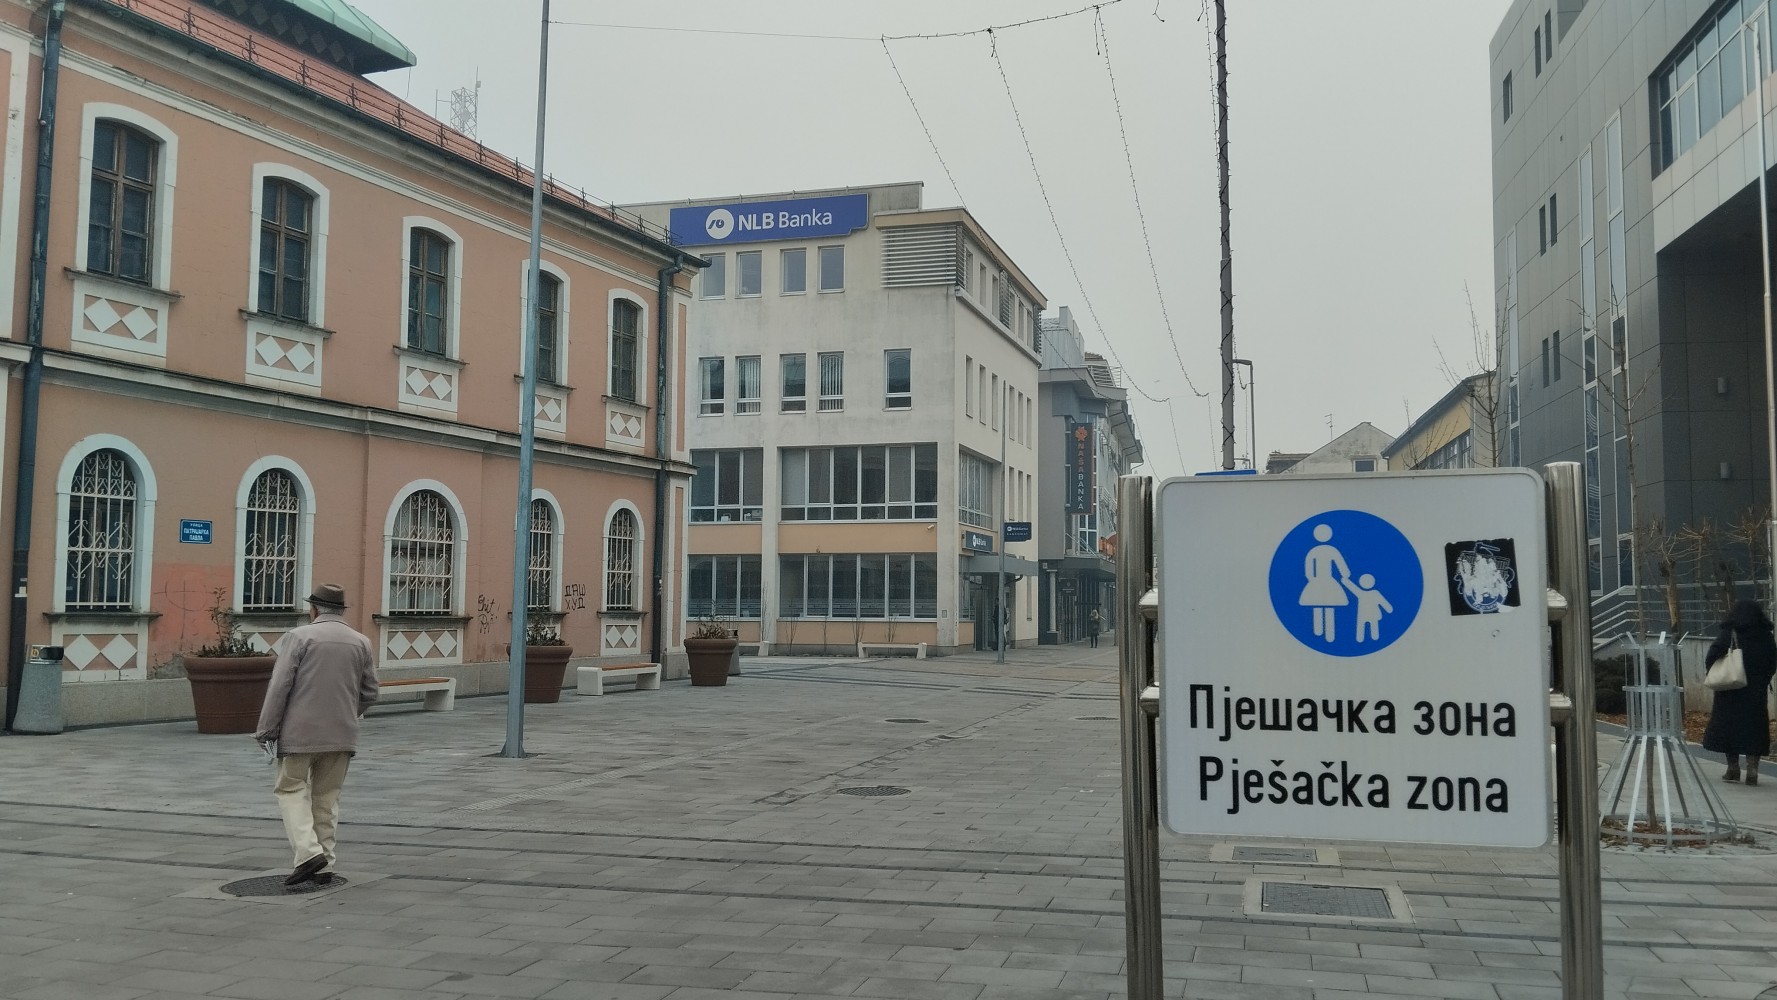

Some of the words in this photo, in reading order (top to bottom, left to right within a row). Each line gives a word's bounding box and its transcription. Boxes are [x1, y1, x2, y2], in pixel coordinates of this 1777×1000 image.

[738, 212, 775, 231] NLB
[778, 208, 833, 229] Banka
[1077, 473, 1085, 510] BANKA
[1189, 683, 1396, 742] Пјешачка
[1412, 700, 1517, 738] зона
[1199, 755, 1390, 815] Pješačka
[1406, 774, 1509, 814] zona
